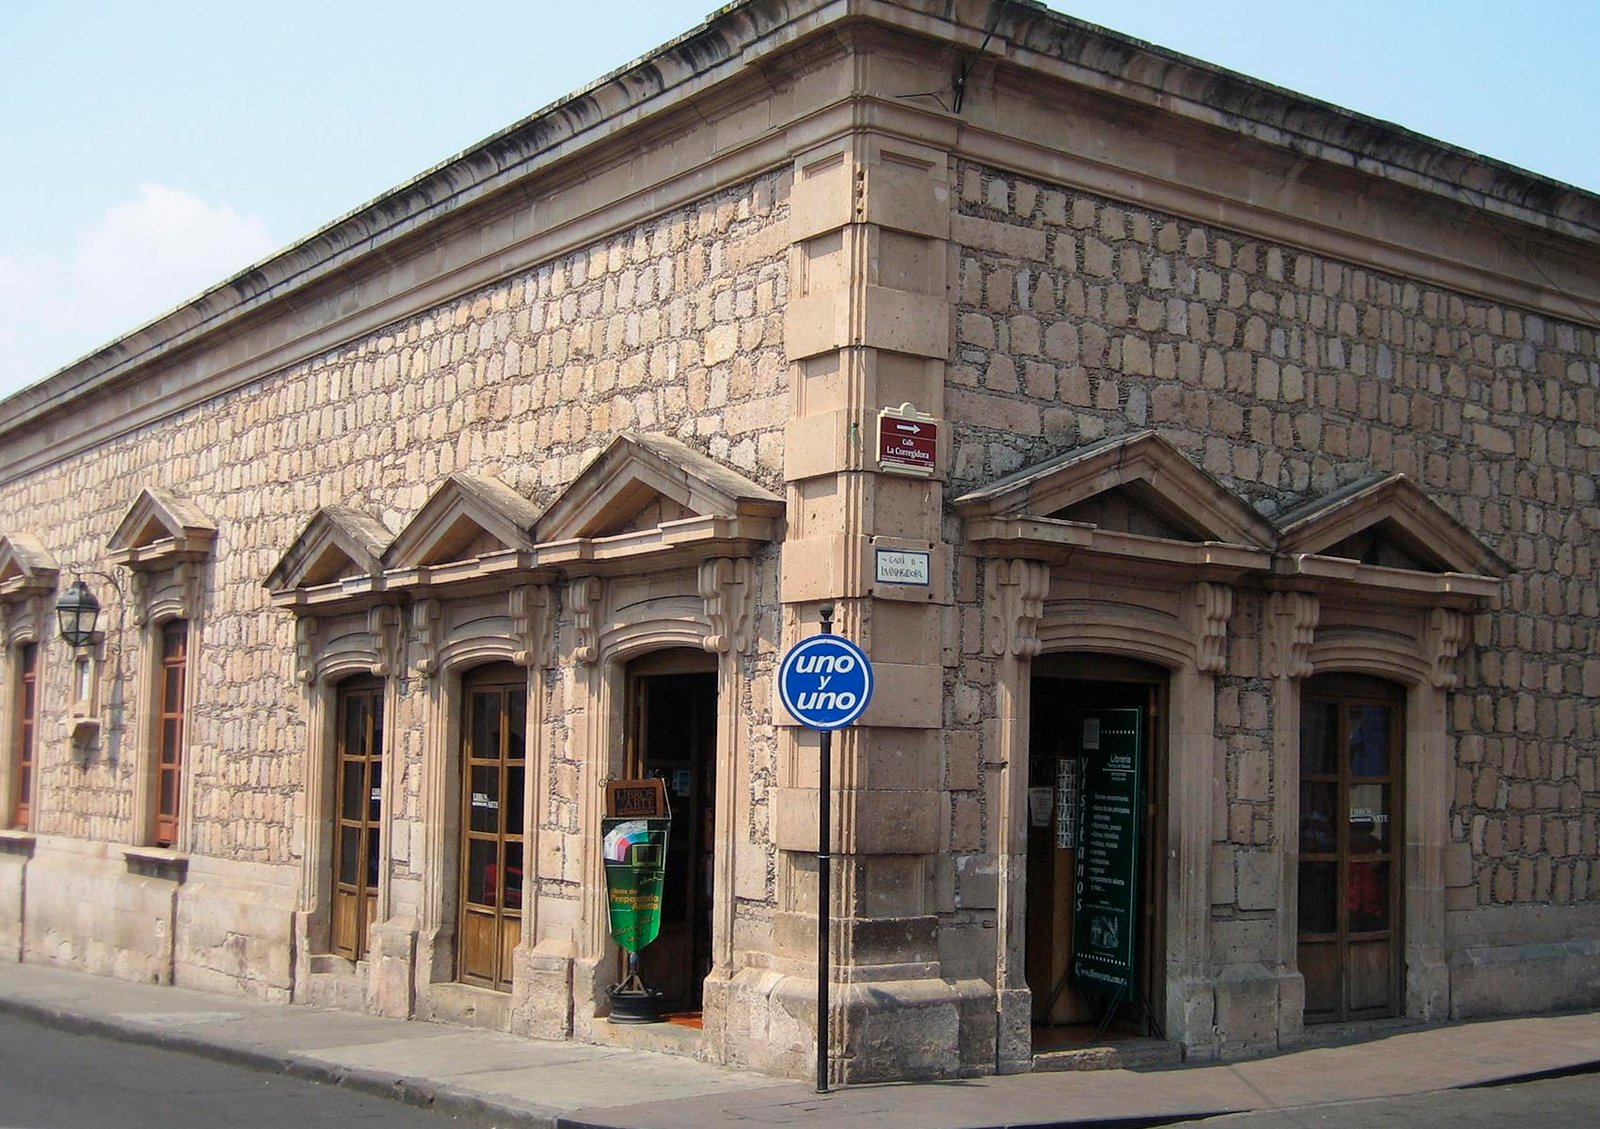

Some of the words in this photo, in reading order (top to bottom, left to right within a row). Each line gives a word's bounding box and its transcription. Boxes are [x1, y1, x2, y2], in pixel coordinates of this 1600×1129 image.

[902, 438, 914, 447] Calle
[886, 446, 894, 454] La
[895, 447, 930, 459] Corregidora
[795, 655, 855, 673] uno
[818, 675, 832, 690] y
[797, 692, 856, 710] uno
[616, 788, 655, 800] LIBROS
